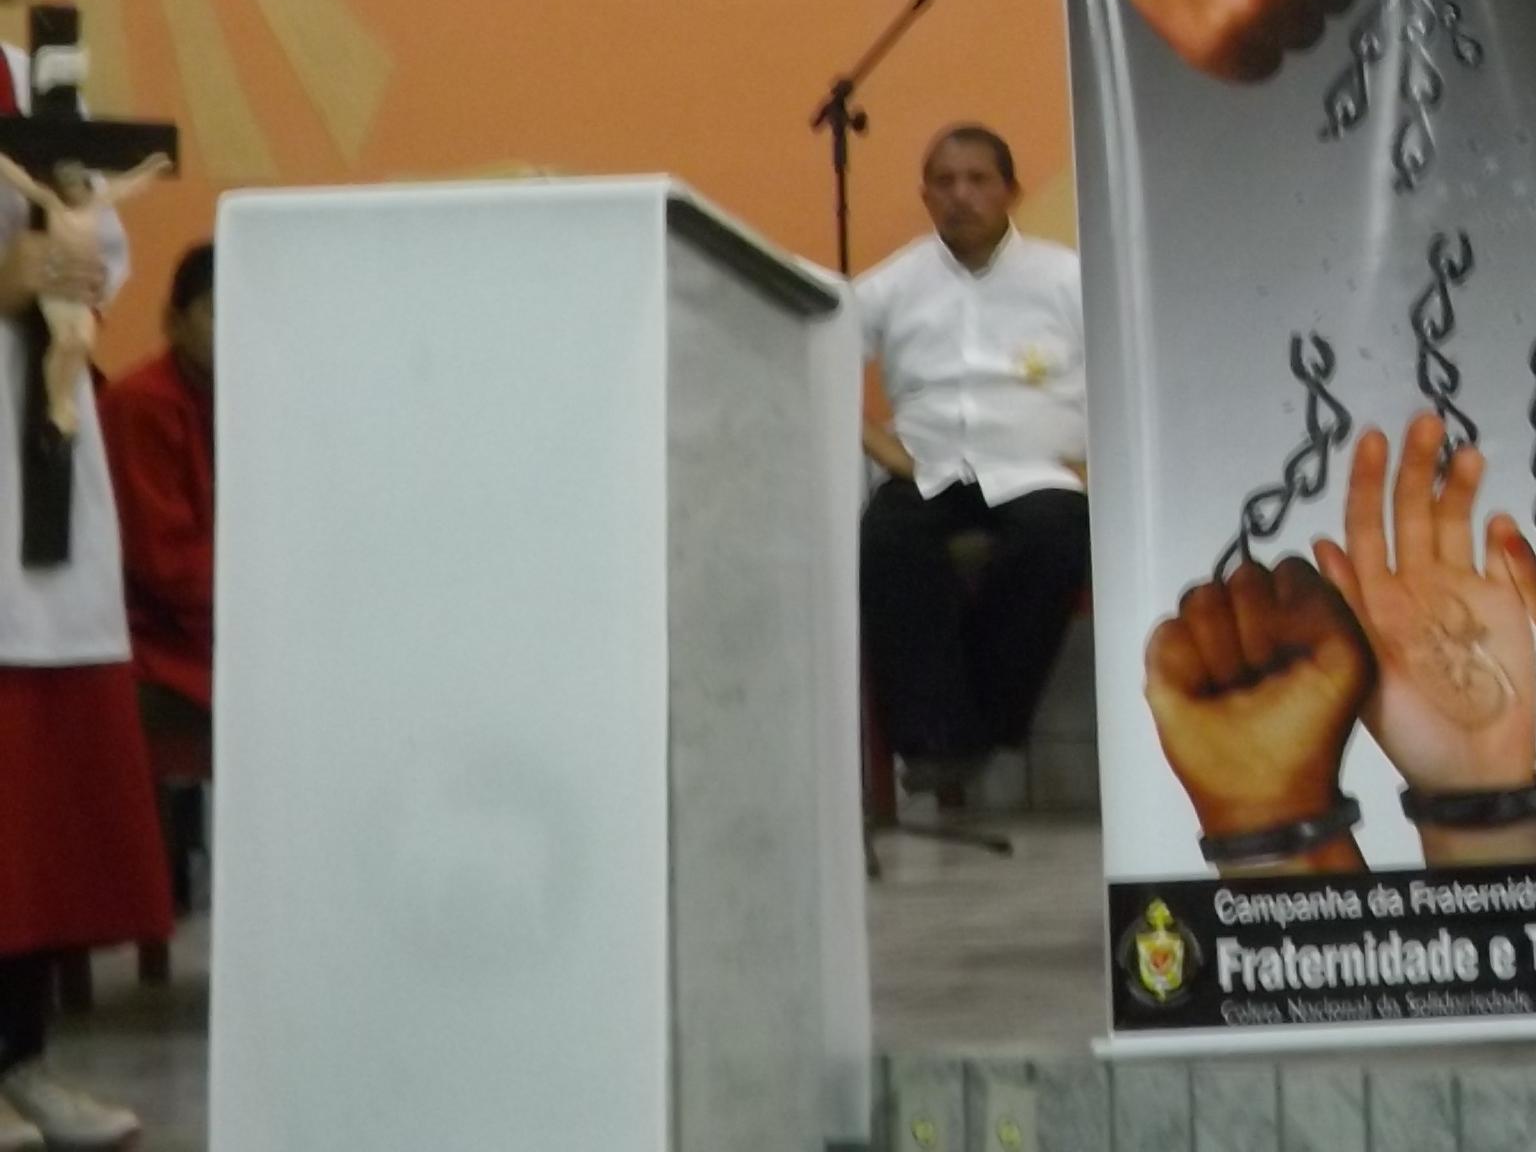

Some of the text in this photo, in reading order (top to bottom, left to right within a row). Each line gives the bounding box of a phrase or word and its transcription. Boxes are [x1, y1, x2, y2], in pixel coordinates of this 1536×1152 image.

[1214, 885, 1363, 928] Campanha
[1367, 882, 1404, 918] da
[1215, 926, 1480, 993] Fraternidade
[1489, 935, 1518, 981] e
